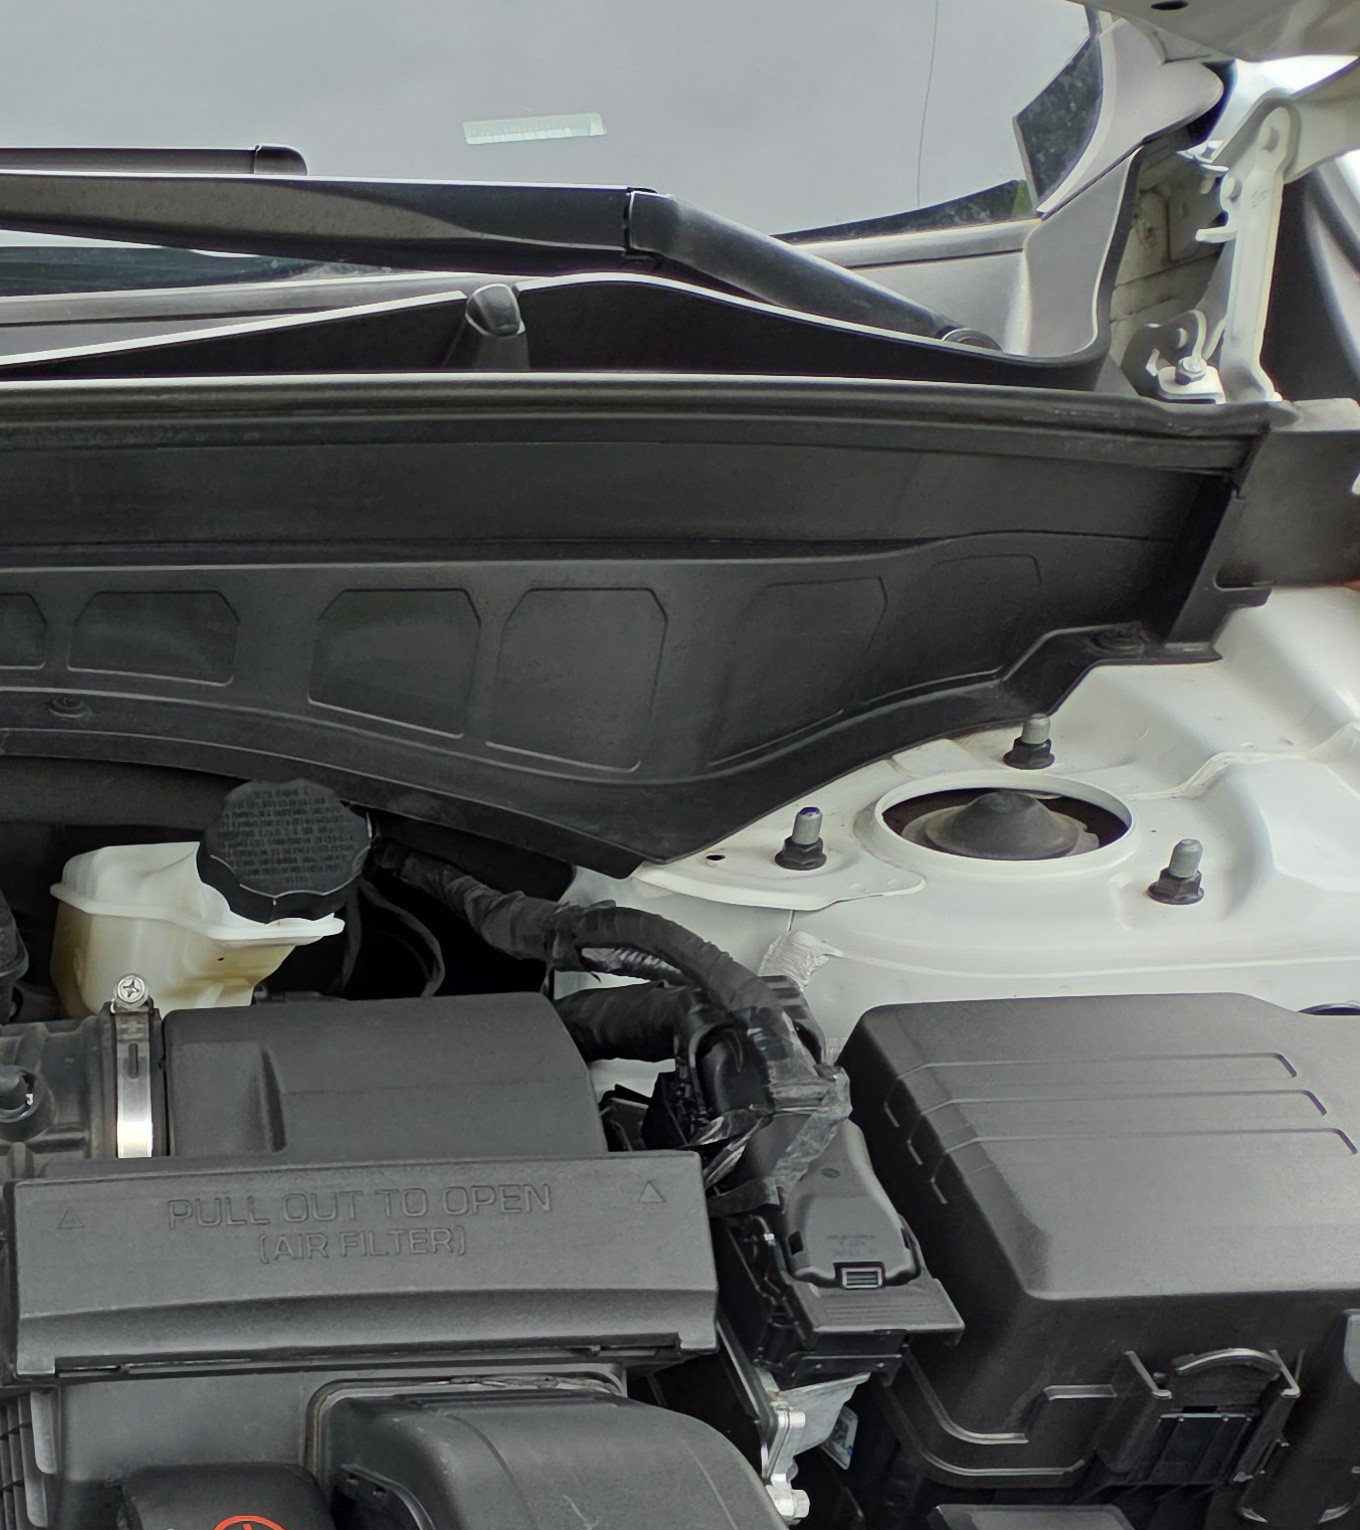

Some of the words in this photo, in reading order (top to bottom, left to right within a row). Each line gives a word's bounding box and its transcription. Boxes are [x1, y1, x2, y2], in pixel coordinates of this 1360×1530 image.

[166, 1194, 271, 1230] PULL
[281, 1189, 365, 1224] OUT
[373, 1187, 430, 1218] TO
[441, 1182, 554, 1216] OPEN
